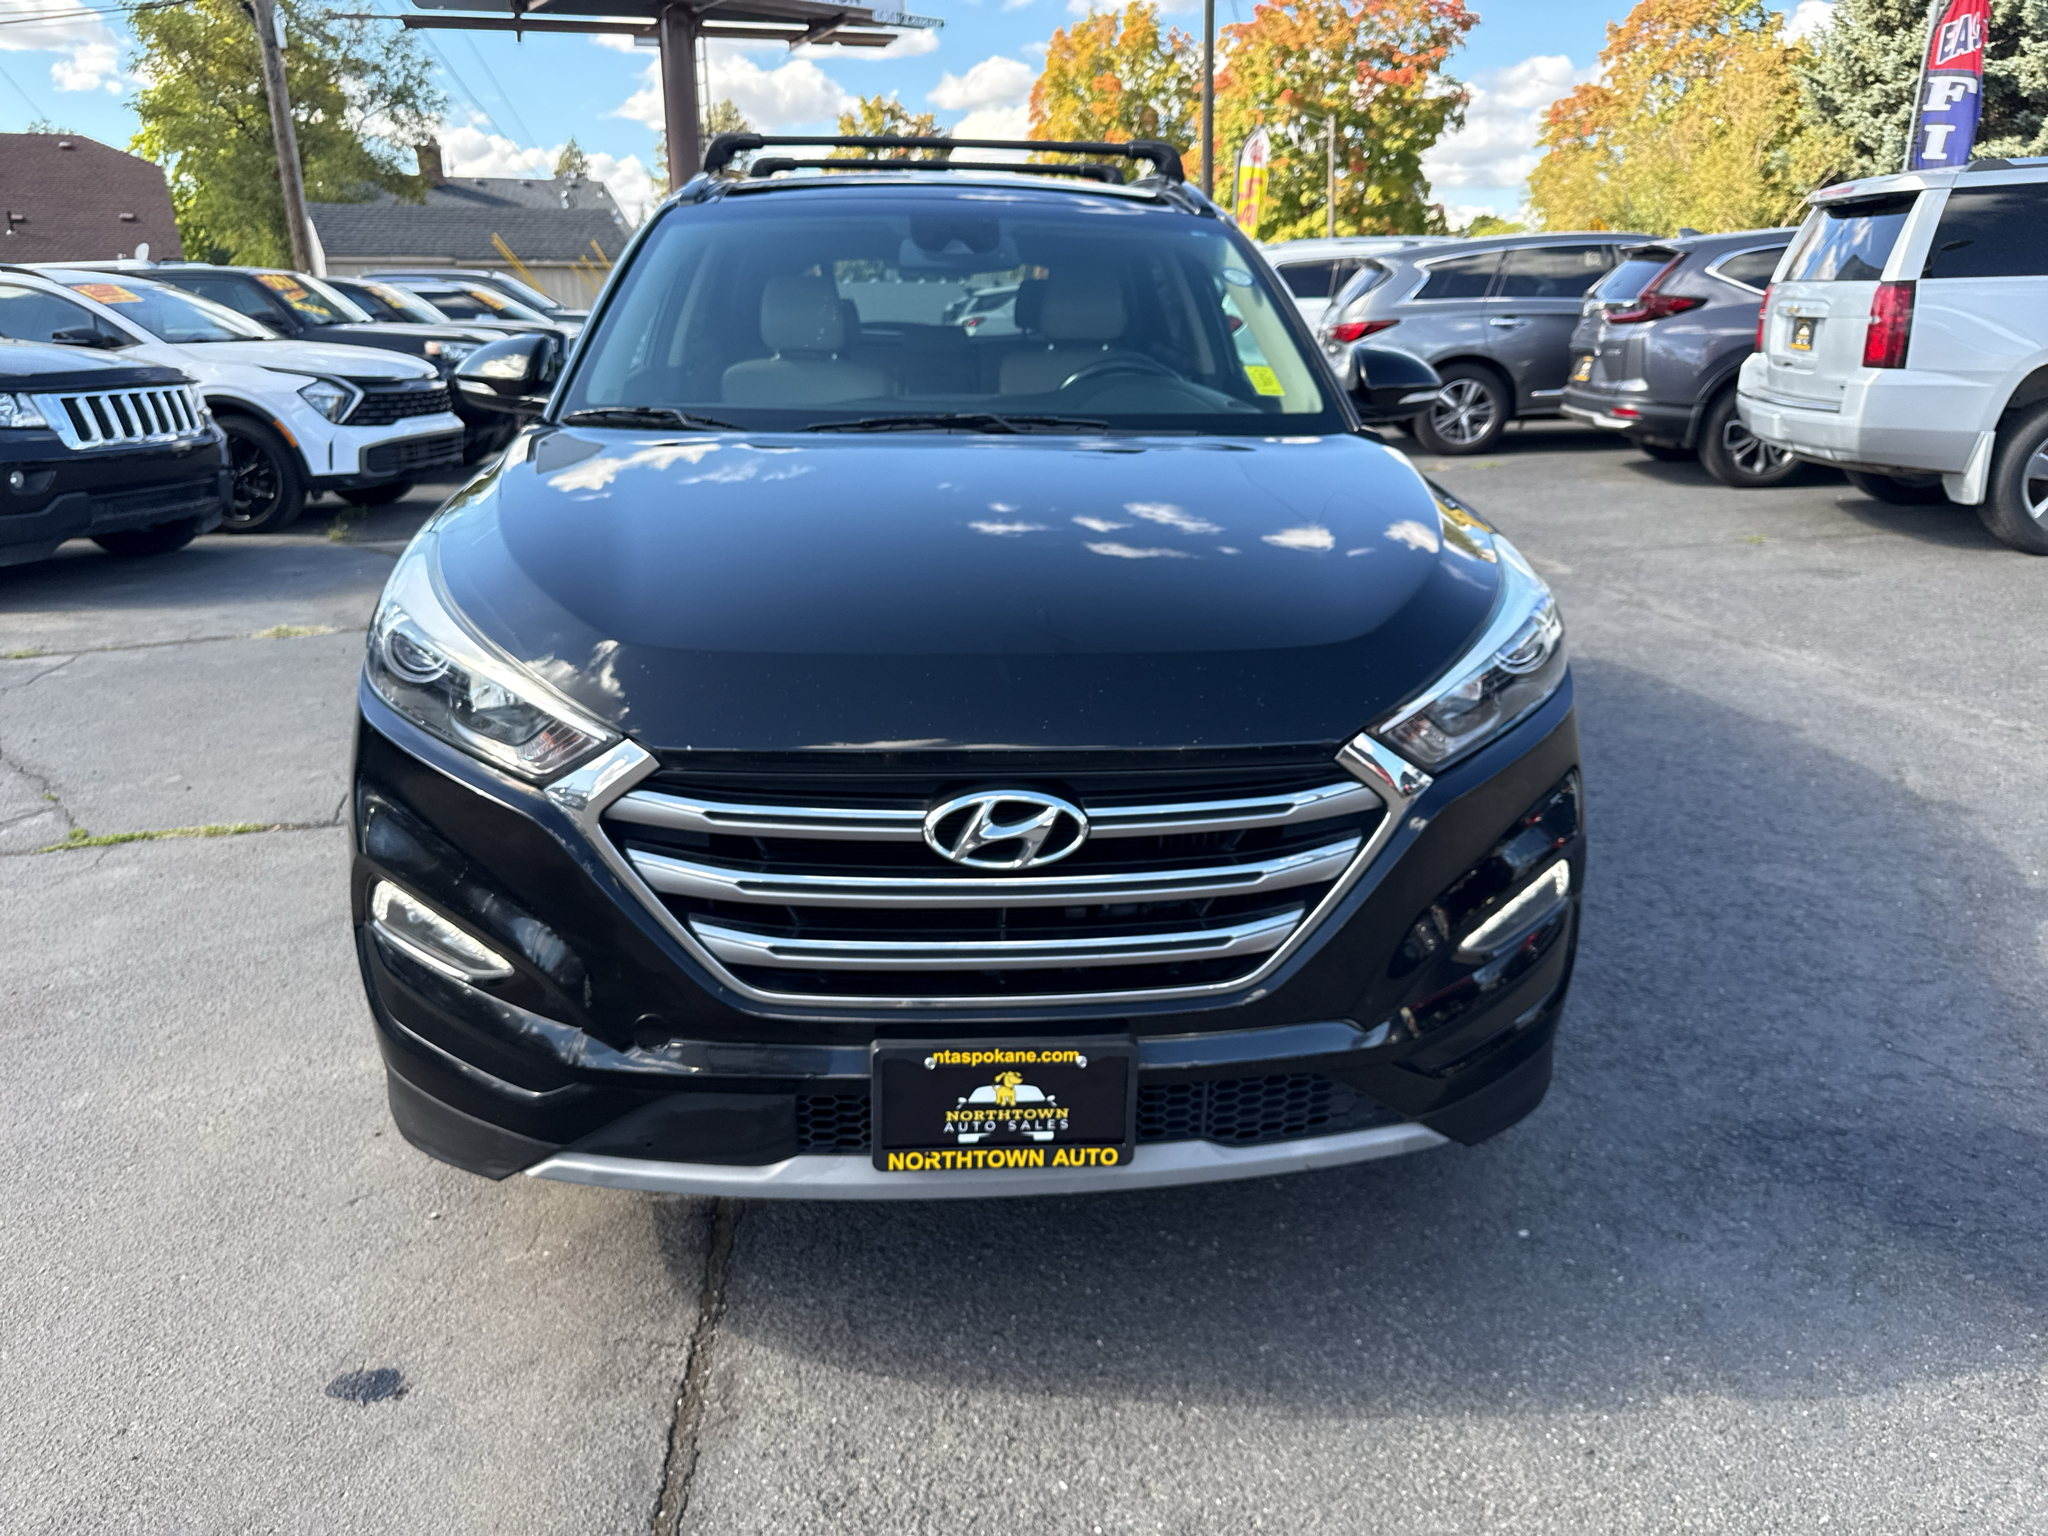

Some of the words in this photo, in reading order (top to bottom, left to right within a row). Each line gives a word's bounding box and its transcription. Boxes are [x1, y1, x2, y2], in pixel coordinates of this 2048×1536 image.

[933, 1048, 1080, 1067] ntaspokane.com
[945, 1108, 1069, 1122] NORTHTOWN
[943, 1120, 996, 1134] AUTO
[1007, 1118, 1069, 1132] SALES
[888, 1149, 1044, 1171] NORTHTOWN
[1052, 1148, 1119, 1167] AUTO
